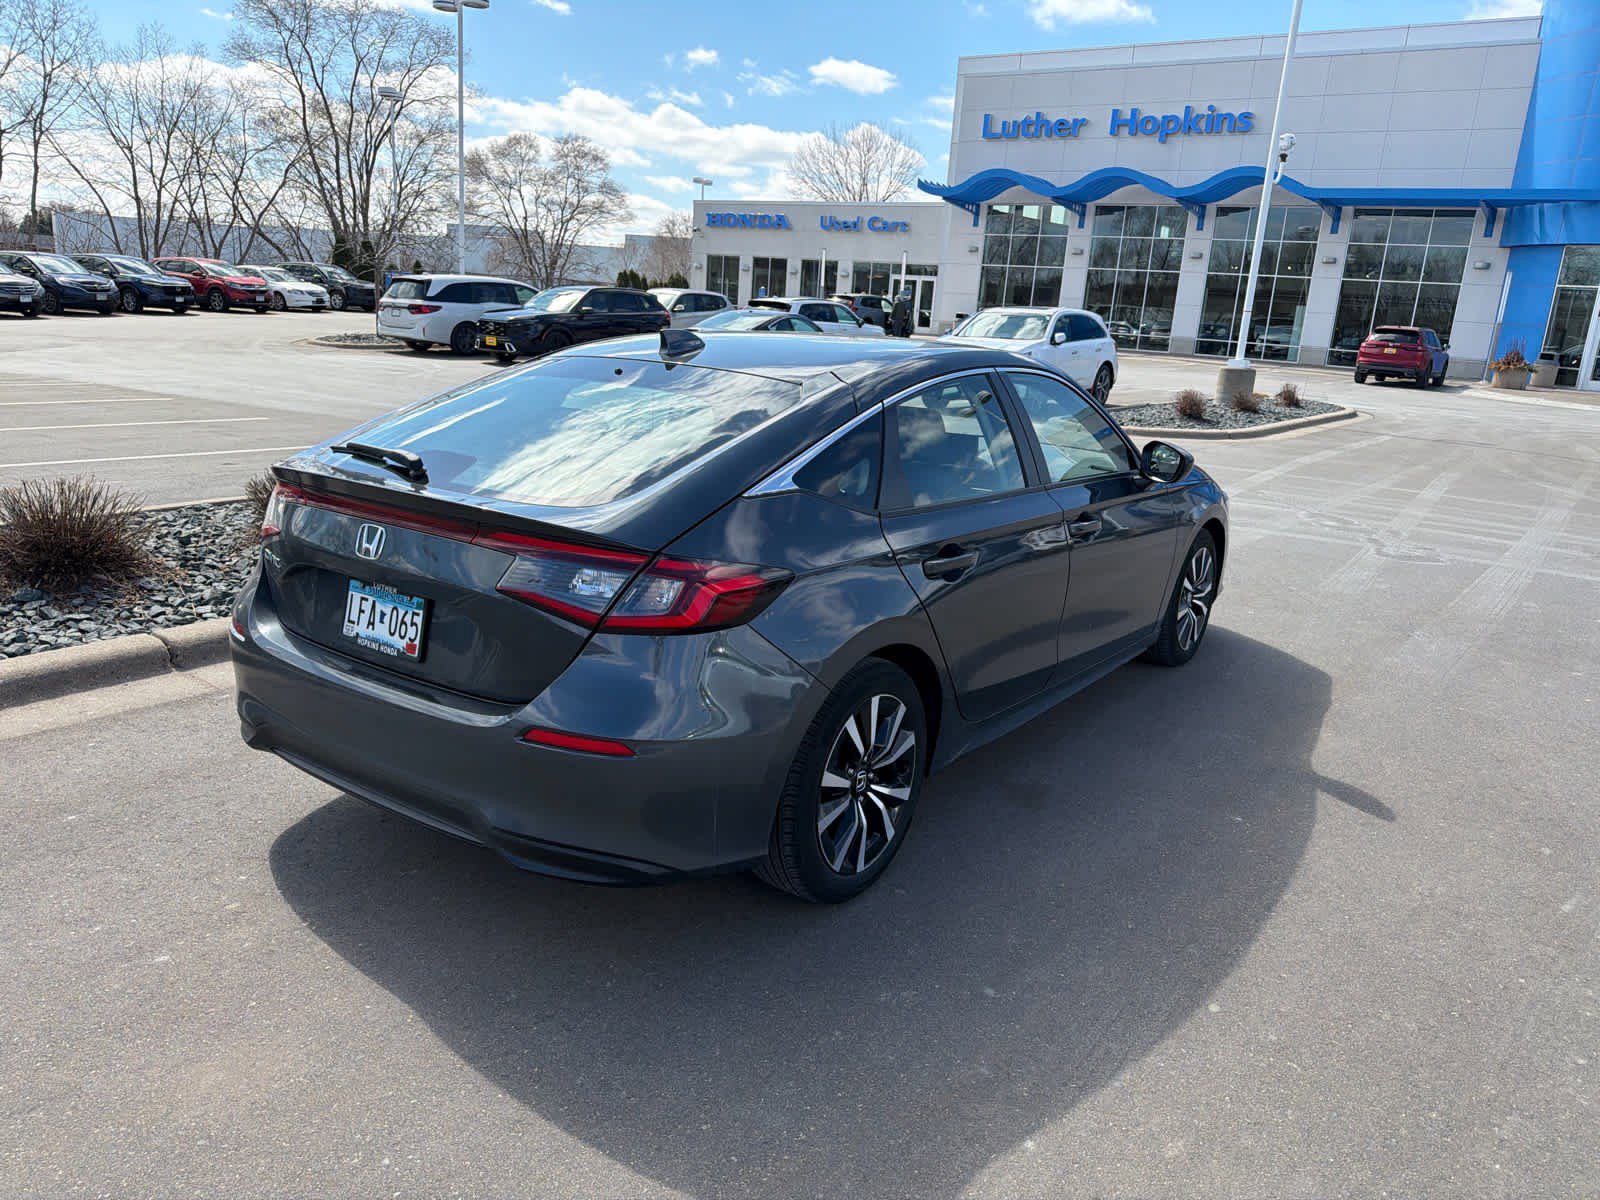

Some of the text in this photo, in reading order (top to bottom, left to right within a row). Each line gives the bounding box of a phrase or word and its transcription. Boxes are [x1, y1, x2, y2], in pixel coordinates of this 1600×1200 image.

[982, 105, 1255, 144] Luther Hopkins
[706, 212, 790, 230] HONDA
[819, 215, 909, 232] Used Cars
[347, 593, 377, 631] LFA
[388, 606, 420, 642] 065
[357, 637, 379, 651] HOPKINS
[380, 644, 398, 656] HONDA
